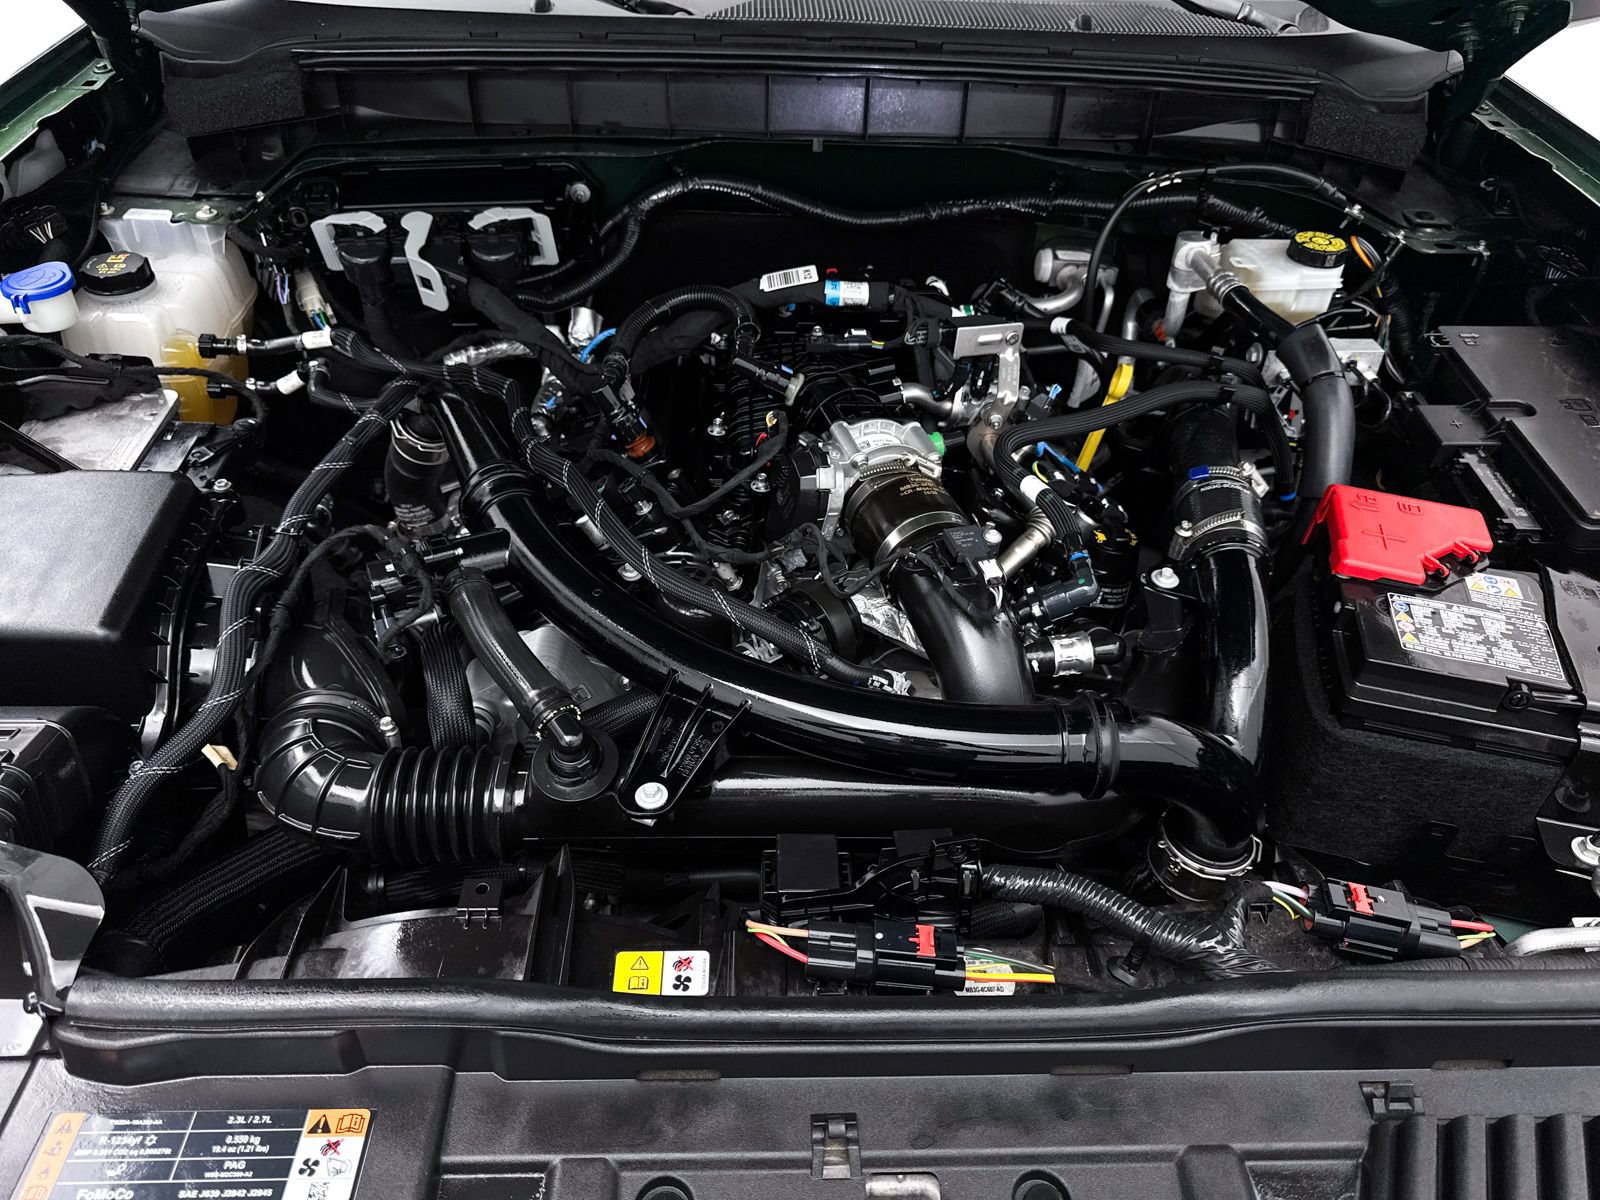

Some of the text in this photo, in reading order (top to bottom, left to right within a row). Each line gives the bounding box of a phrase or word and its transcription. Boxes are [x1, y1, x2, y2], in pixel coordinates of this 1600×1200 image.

[227, 1115, 246, 1124] 2.3L
[253, 1115, 272, 1124] 2.7L
[225, 1135, 261, 1145] 0.550 kg
[223, 1161, 247, 1170] PAG
[76, 1187, 135, 1200] FoMoCo
[178, 1189, 199, 1199] SAE
